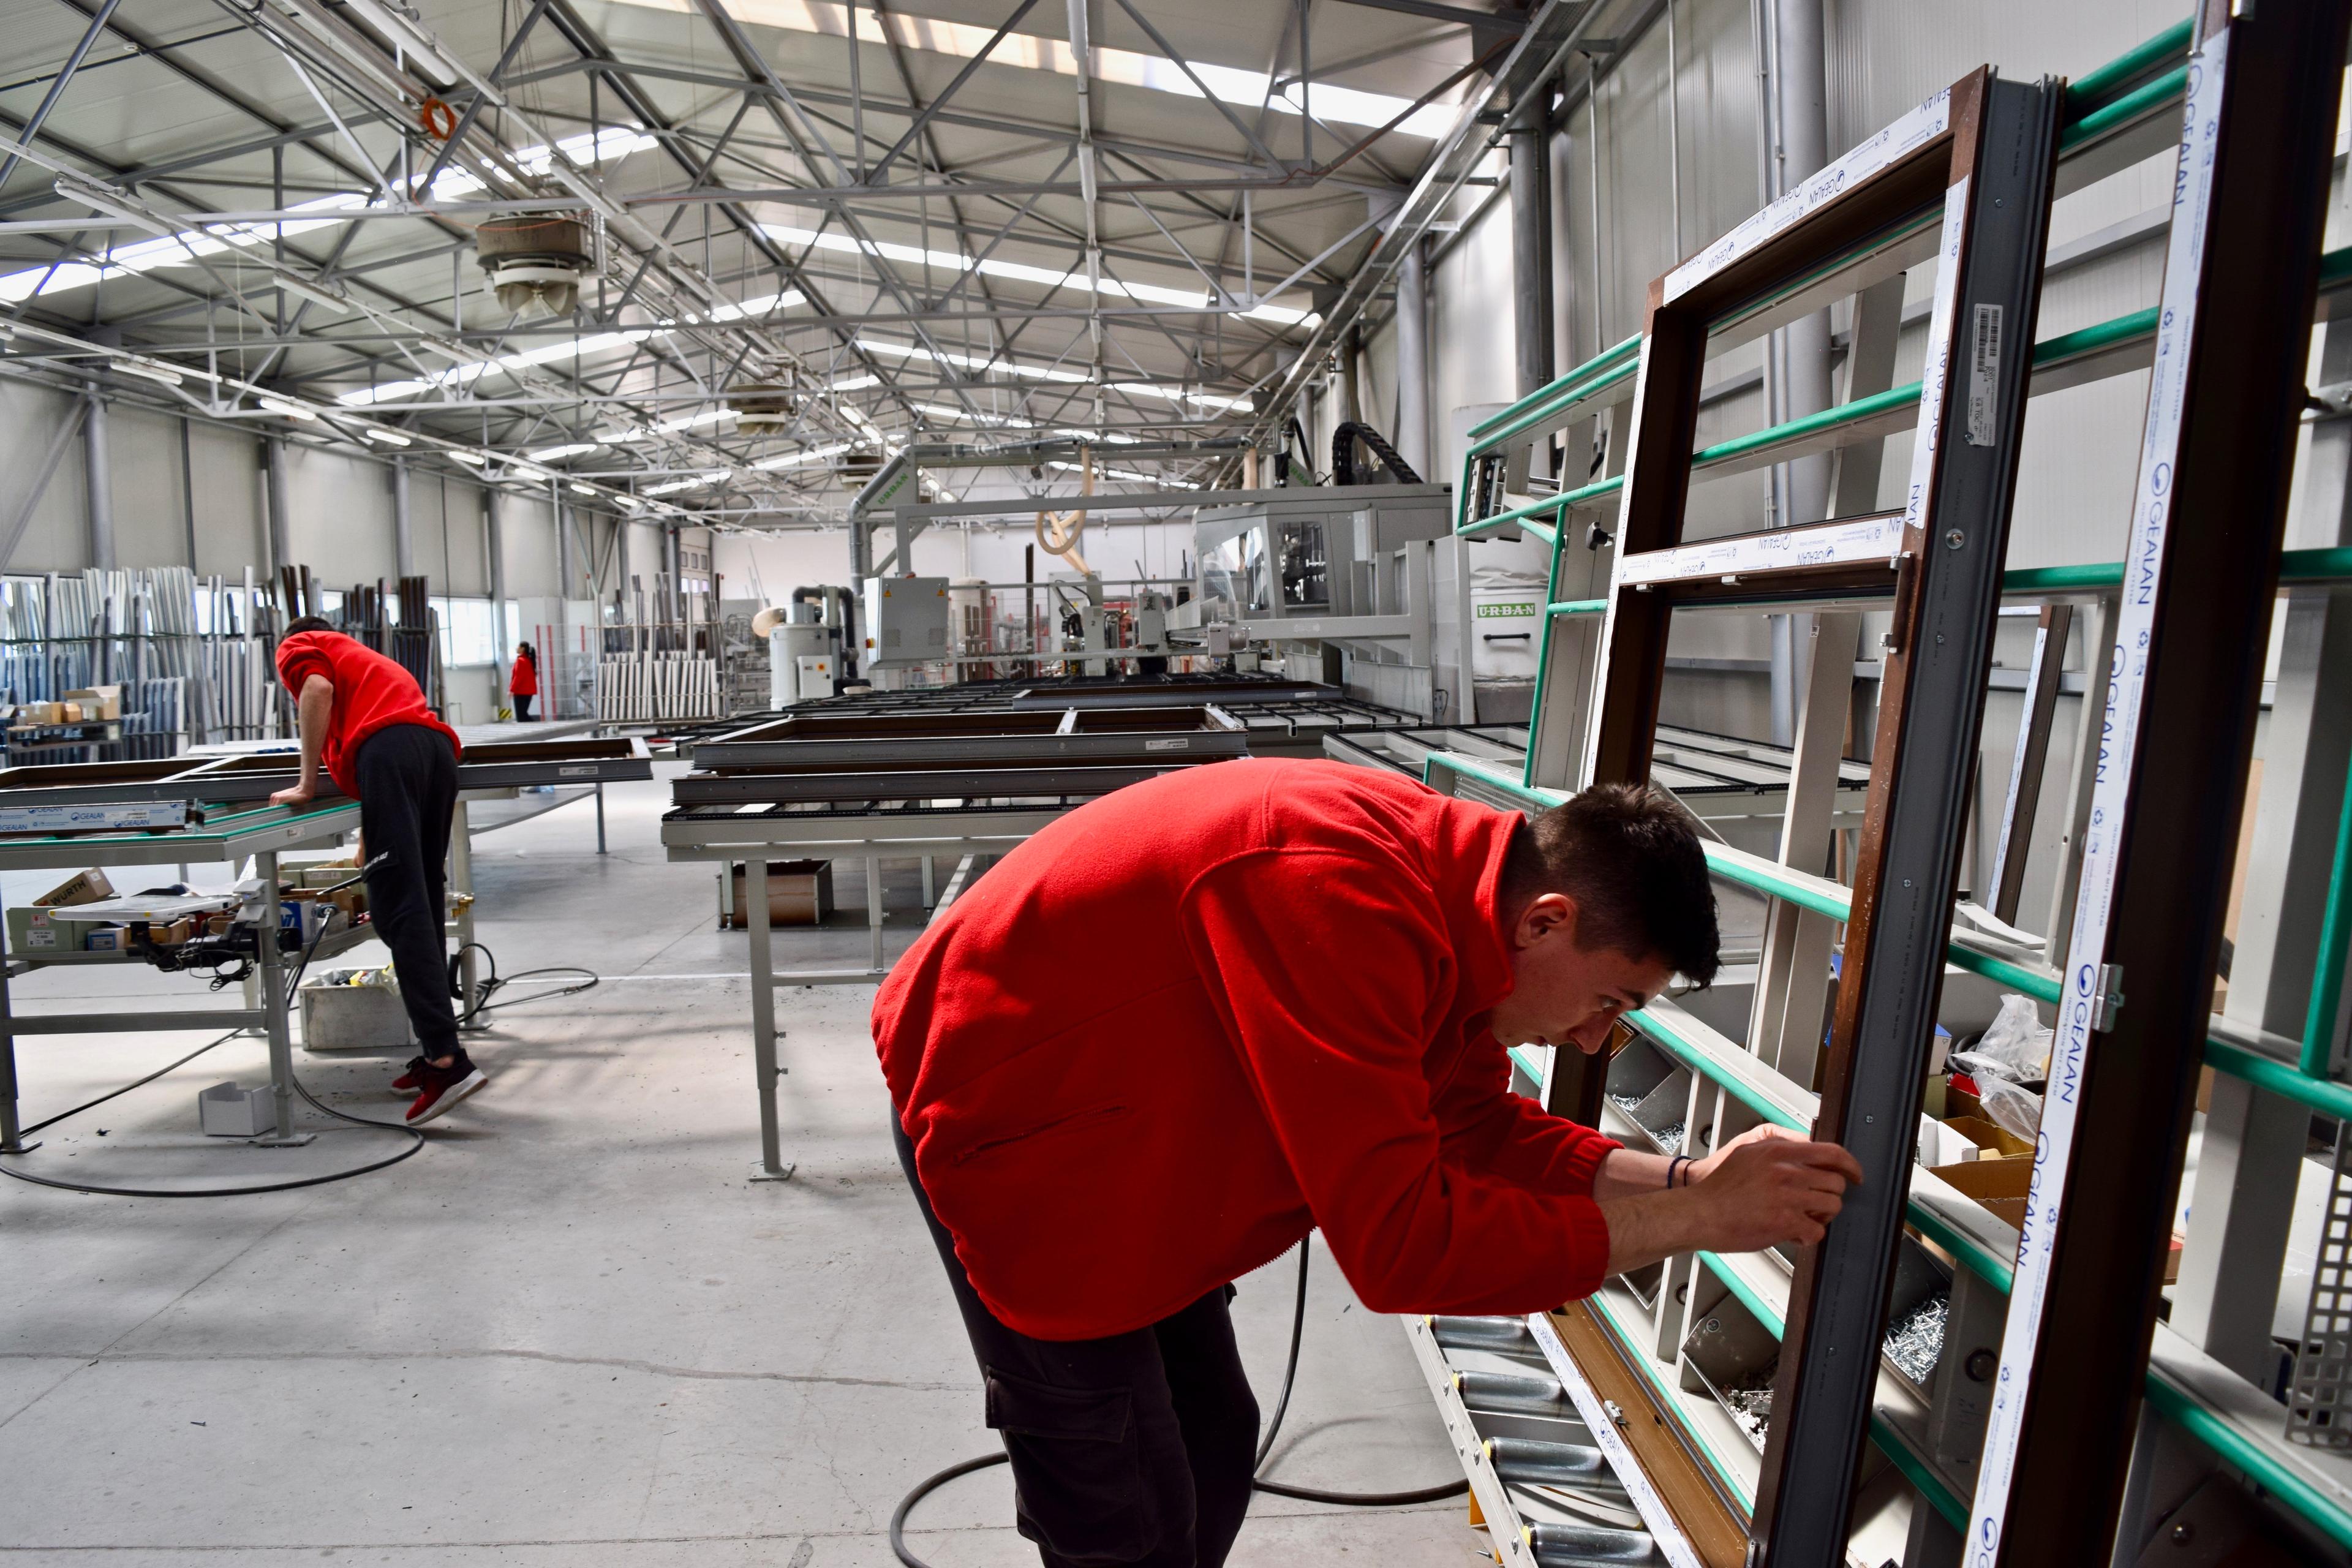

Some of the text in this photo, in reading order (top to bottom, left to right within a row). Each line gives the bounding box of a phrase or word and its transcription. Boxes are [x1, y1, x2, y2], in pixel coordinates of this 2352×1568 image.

[1809, 178, 1836, 205] GEALAN
[2138, 502, 2162, 604] GEALAN
[2061, 1001, 2086, 1103] GEALAN
[2062, 997, 2071, 1046] INNOVATION
